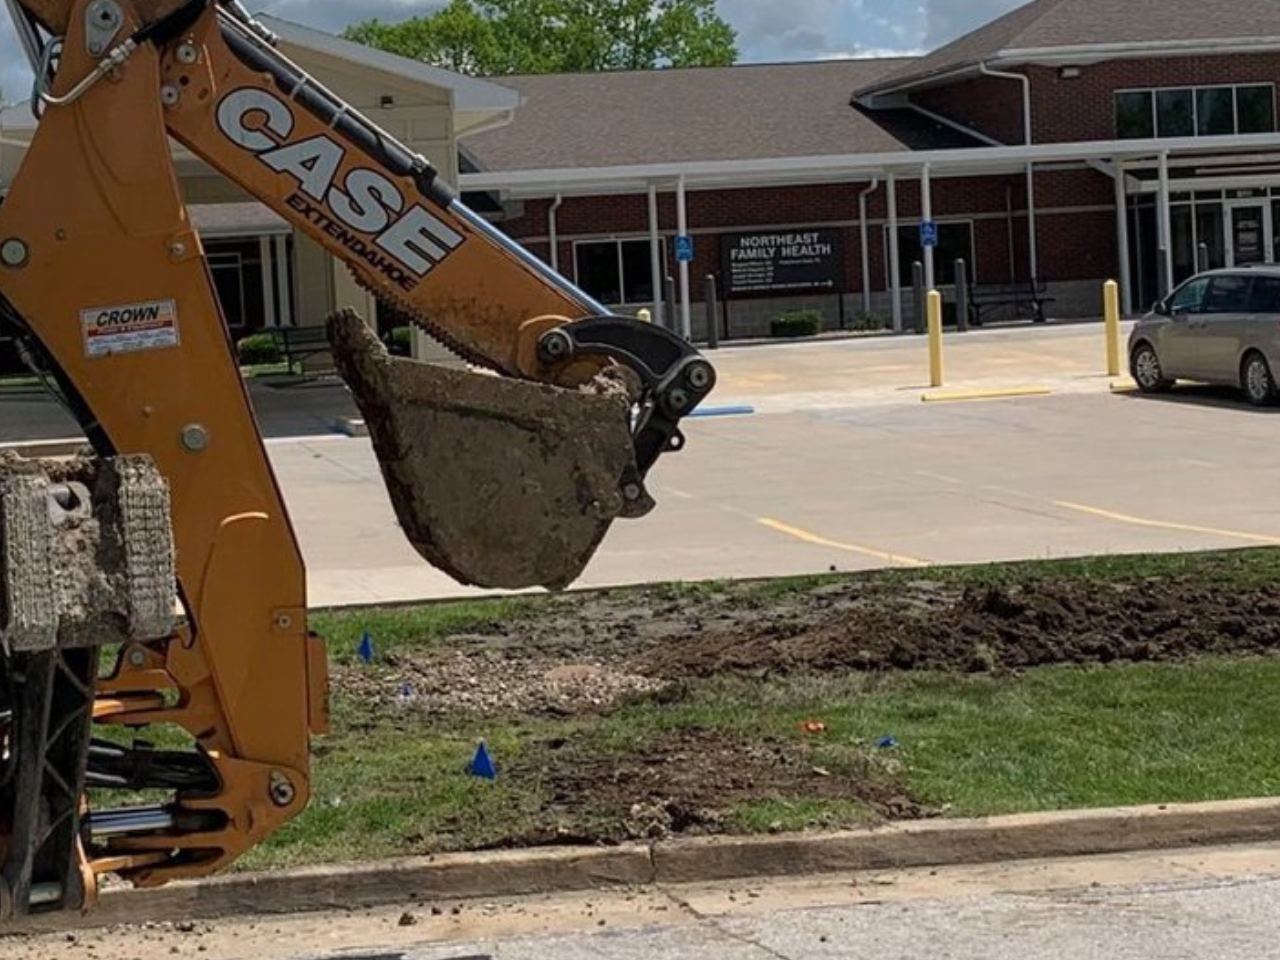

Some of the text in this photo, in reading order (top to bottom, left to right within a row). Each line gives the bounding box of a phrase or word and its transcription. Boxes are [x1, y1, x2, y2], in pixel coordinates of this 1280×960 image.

[216, 86, 466, 277] CASE
[285, 193, 419, 291] EXTENDAHOE
[740, 232, 819, 247] NORTHEAST
[730, 243, 832, 260] FAMILY HEALTH
[96, 305, 160, 327] CROWN
